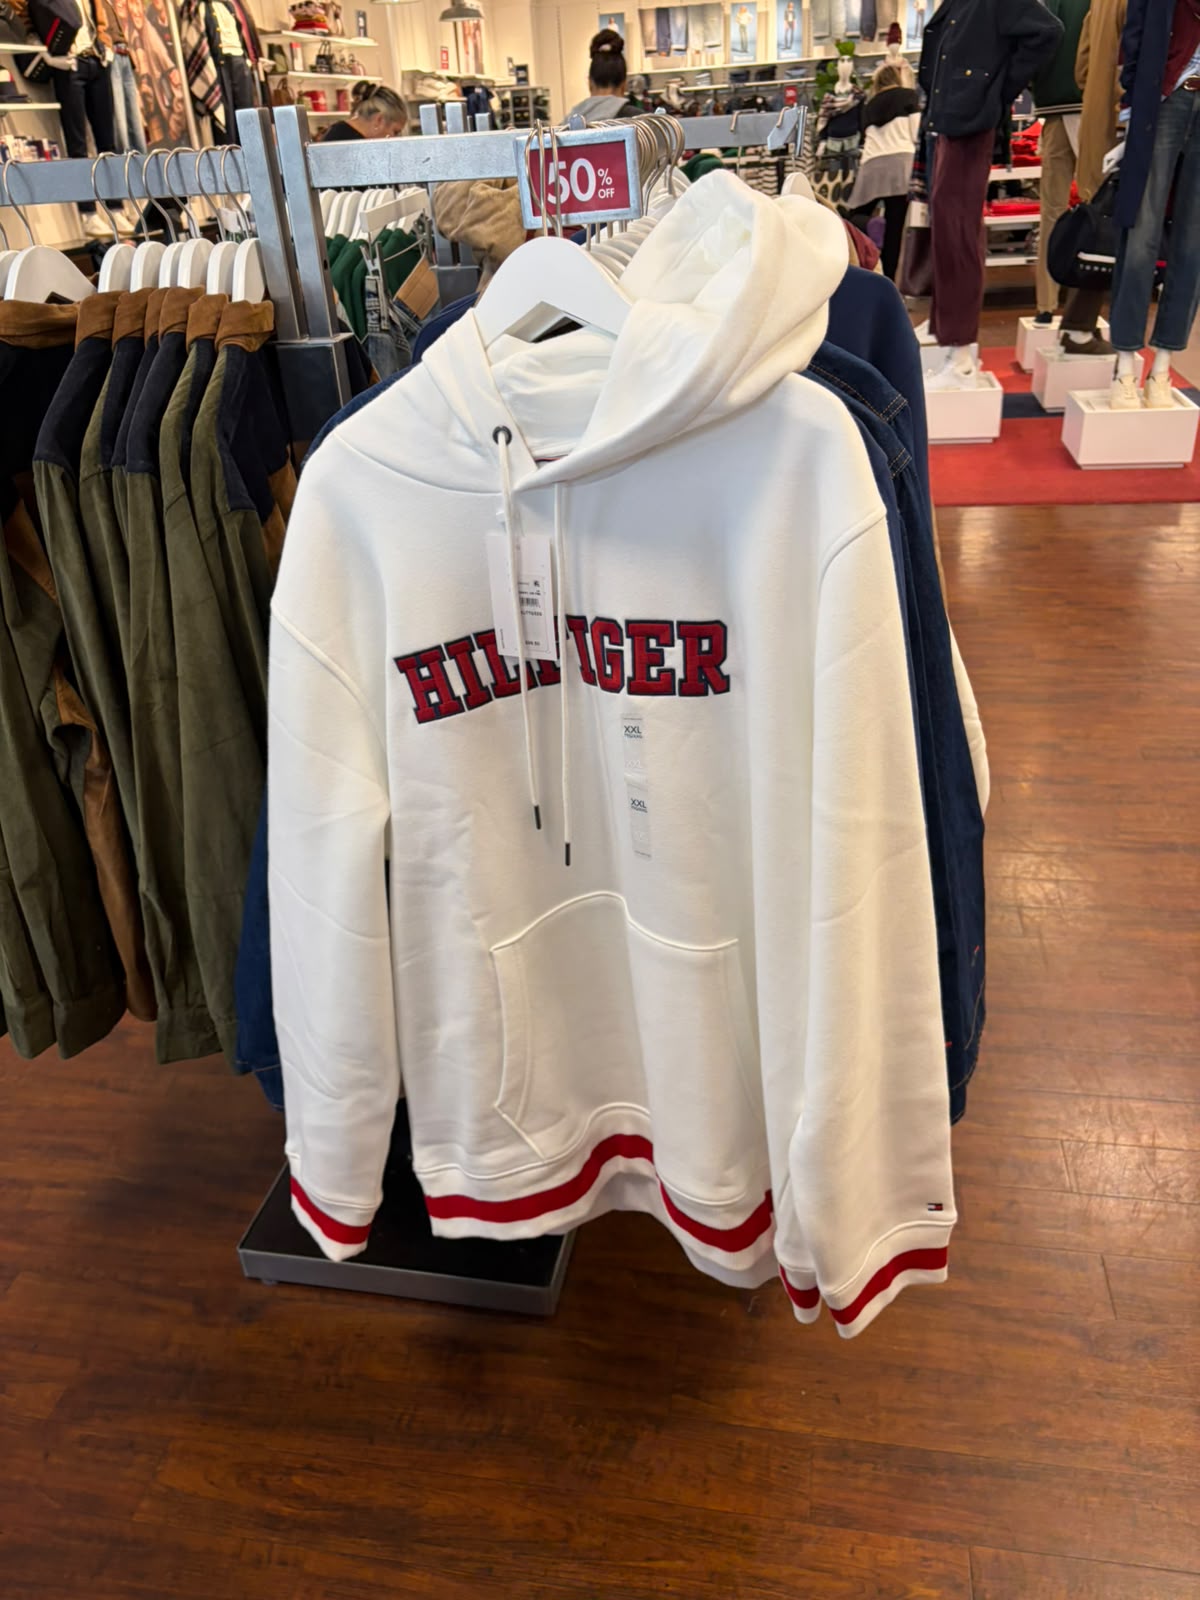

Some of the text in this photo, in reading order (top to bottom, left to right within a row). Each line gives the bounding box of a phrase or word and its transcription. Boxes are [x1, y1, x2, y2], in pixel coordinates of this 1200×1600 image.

[598, 188, 615, 199] OFF
[624, 725, 642, 734] XXL
[630, 797, 647, 809] XXL
